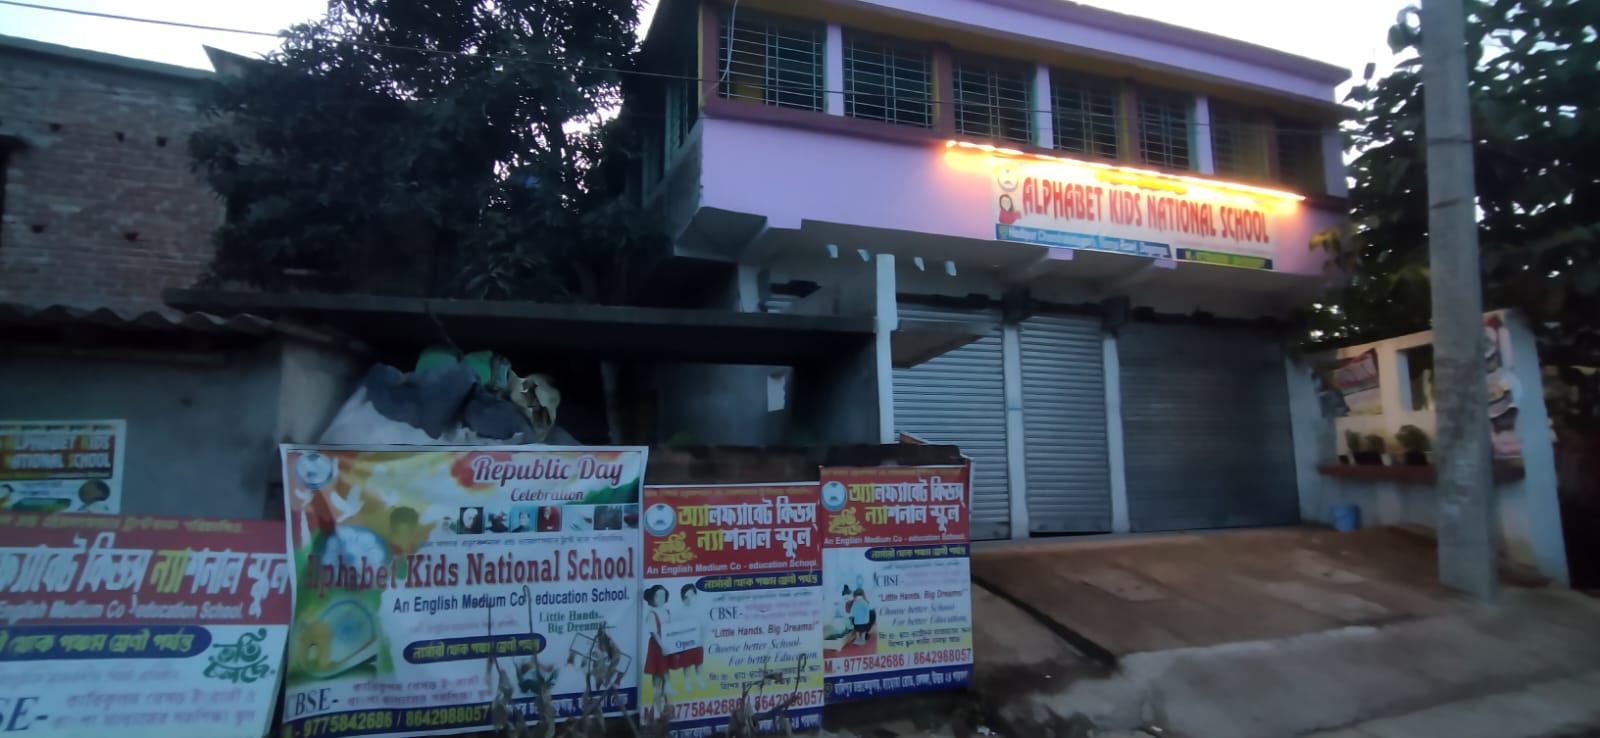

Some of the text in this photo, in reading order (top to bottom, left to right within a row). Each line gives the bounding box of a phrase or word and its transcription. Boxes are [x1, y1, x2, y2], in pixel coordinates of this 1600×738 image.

[1022, 177, 1103, 222] ALPHABET
[1109, 188, 1142, 227] KIDS
[1147, 195, 1216, 239] NATIONAL
[1220, 206, 1269, 244] SCHOOL
[474, 455, 624, 487] Republic Day
[510, 488, 584, 502] Celebration
[405, 553, 459, 588] Kids
[466, 550, 561, 587] National
[567, 547, 634, 582] School
[647, 565, 658, 575] An
[661, 564, 692, 576] English
[695, 562, 728, 572] Medium
[729, 561, 741, 570] Co
[748, 561, 788, 571] education
[393, 598, 410, 613] An
[414, 594, 459, 615] English
[462, 593, 507, 609] Medium
[535, 589, 589, 605] education
[591, 586, 630, 603] School.
[924, 590, 936, 600] Big
[907, 604, 928, 614] better
[547, 623, 564, 635] Big
[767, 624, 781, 636] Big
[743, 639, 768, 652] better
[843, 653, 905, 673] 9775842686
[913, 647, 972, 665] 8642988057
